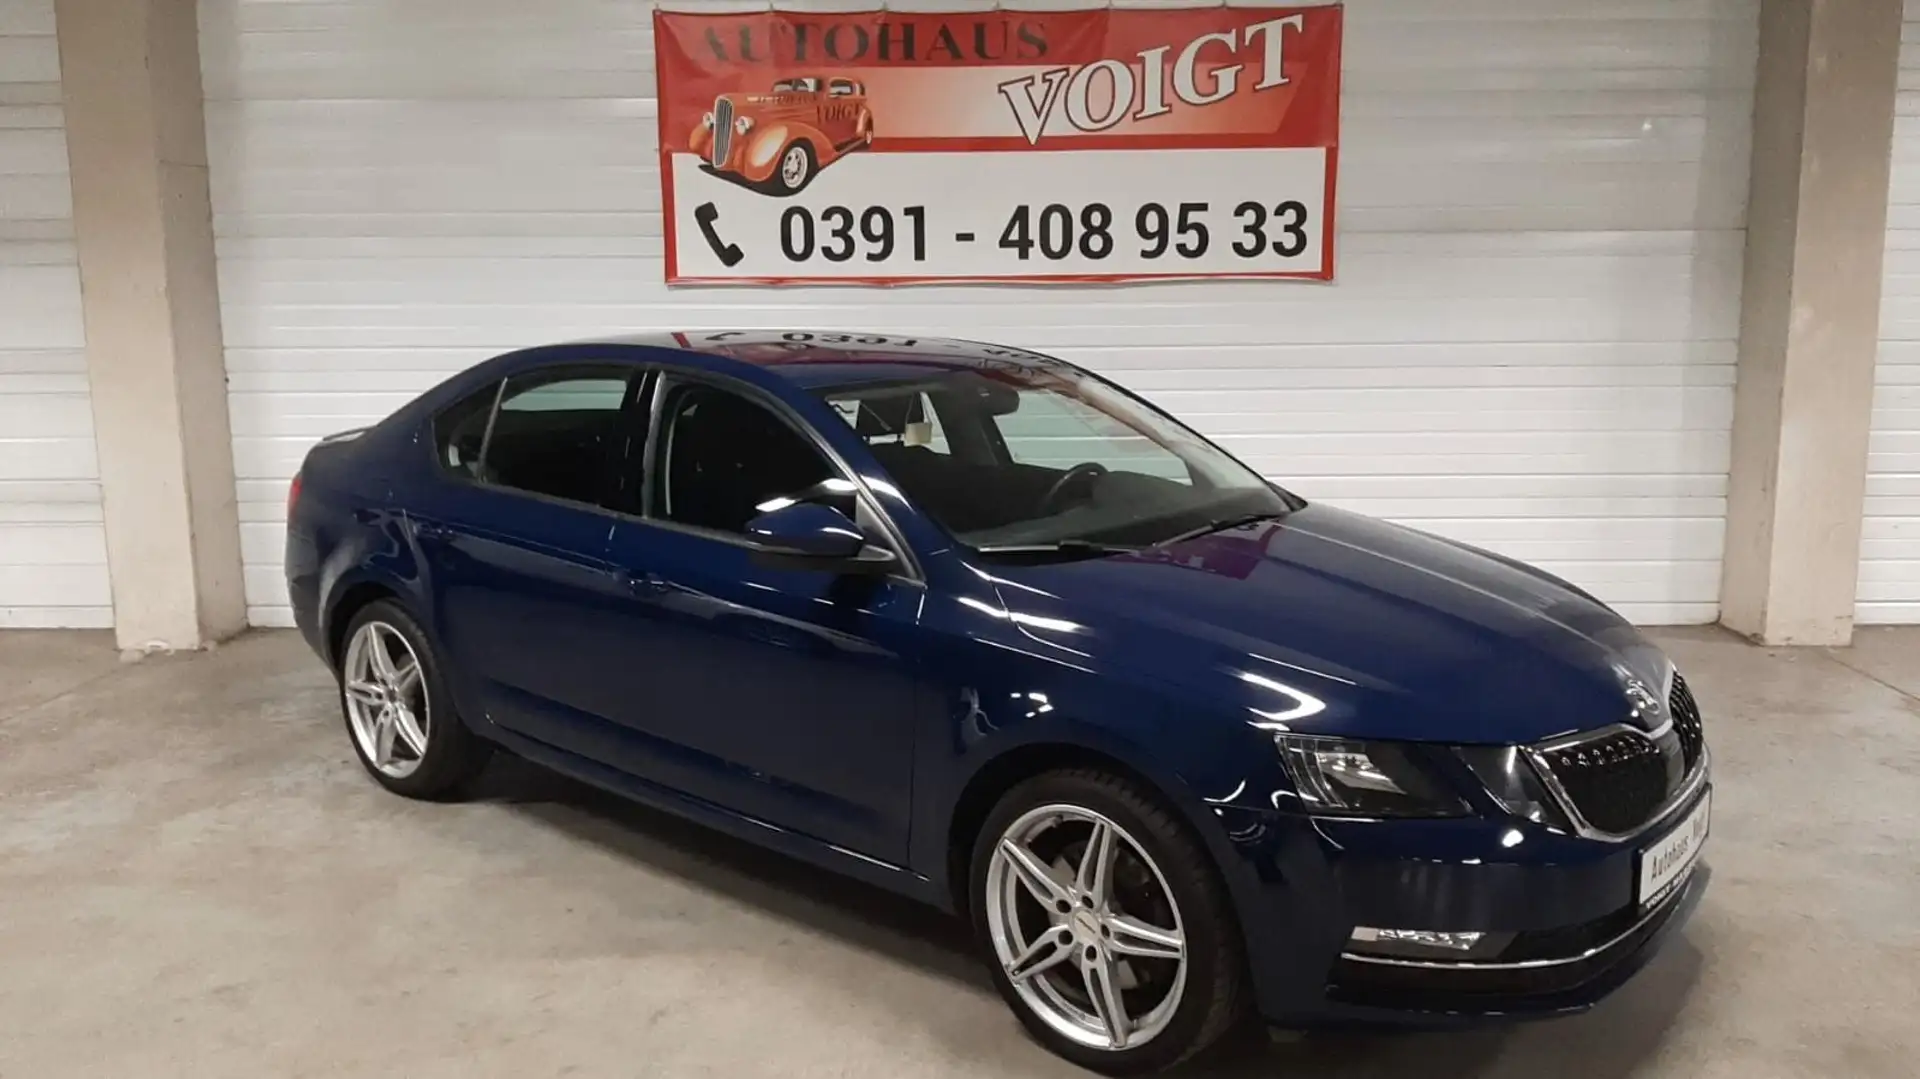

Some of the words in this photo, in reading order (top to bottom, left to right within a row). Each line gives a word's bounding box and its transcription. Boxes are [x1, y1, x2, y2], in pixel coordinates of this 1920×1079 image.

[700, 21, 1047, 63] AUTOHAUS
[998, 15, 1303, 145] VOIGT
[780, 205, 926, 261] 0391
[998, 203, 1114, 260] 408
[1136, 203, 1209, 259] 95
[1232, 201, 1308, 258] 33
